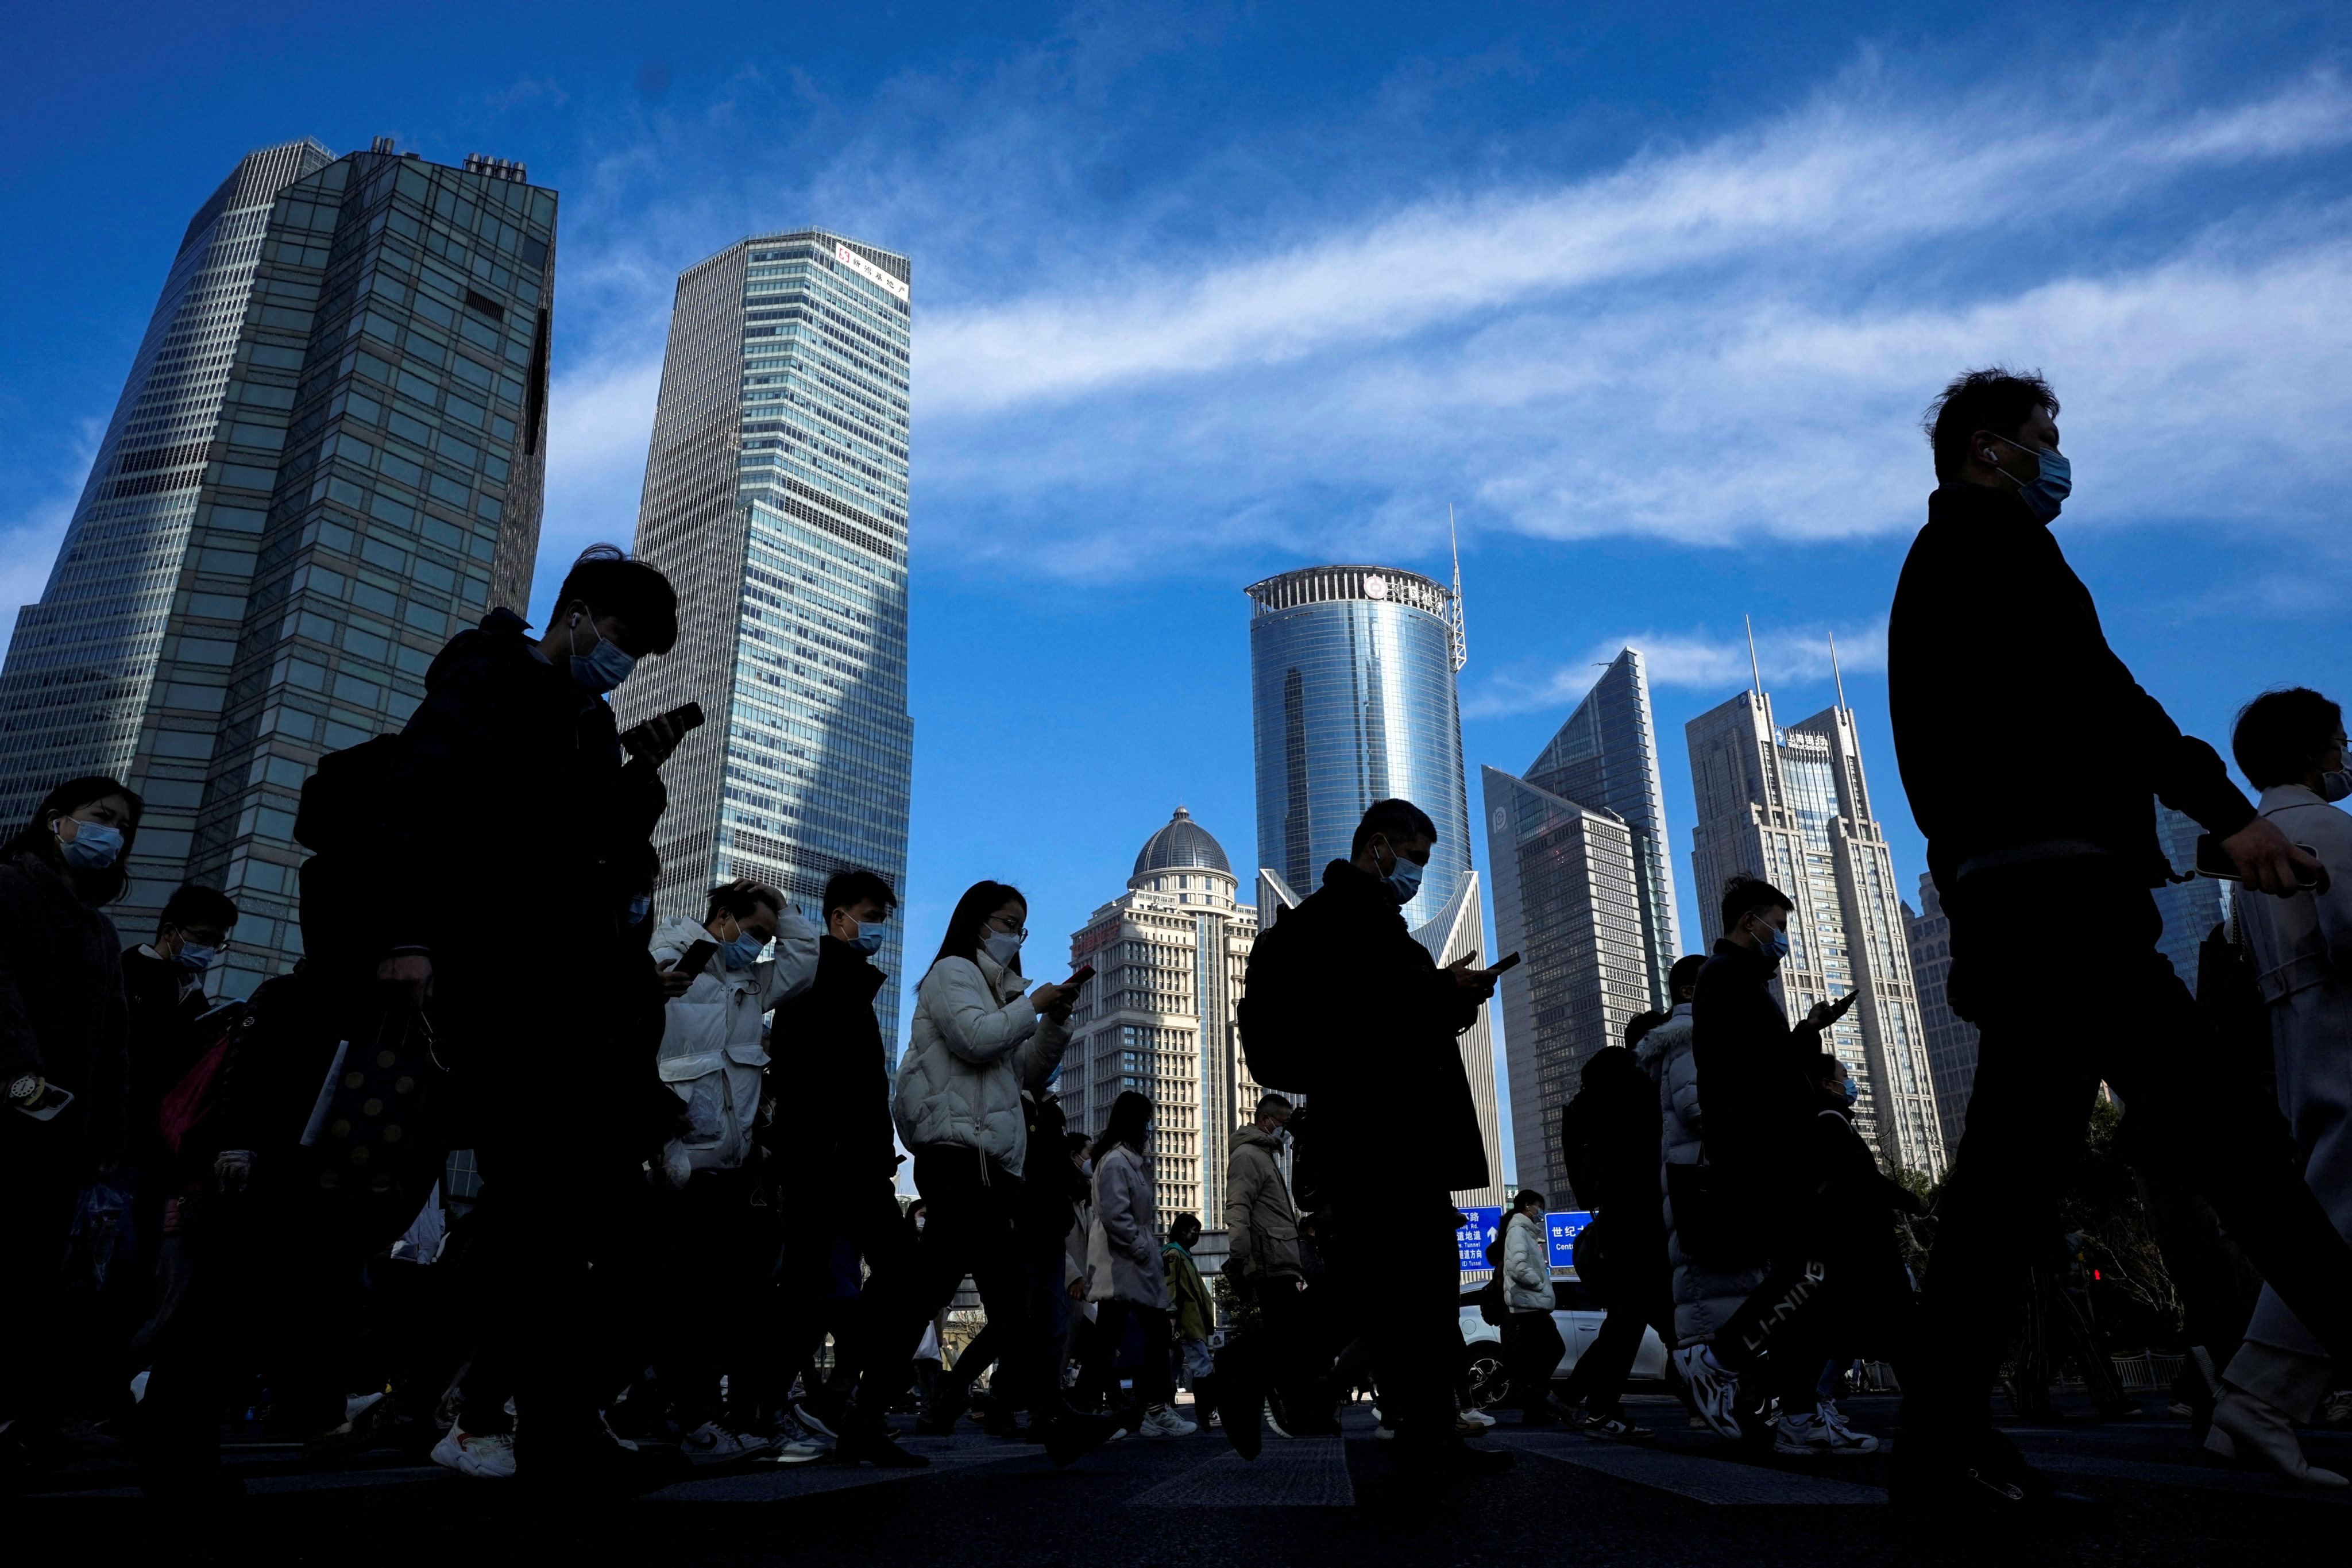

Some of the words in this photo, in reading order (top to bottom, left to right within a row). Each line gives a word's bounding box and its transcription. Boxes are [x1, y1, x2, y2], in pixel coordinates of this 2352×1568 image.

[853, 258, 905, 292] 新鸿基地产
[1787, 732, 1828, 747] 上海银行
[1072, 922, 1120, 959] 中国平安
[1741, 1259, 1825, 1351] LI-NING
